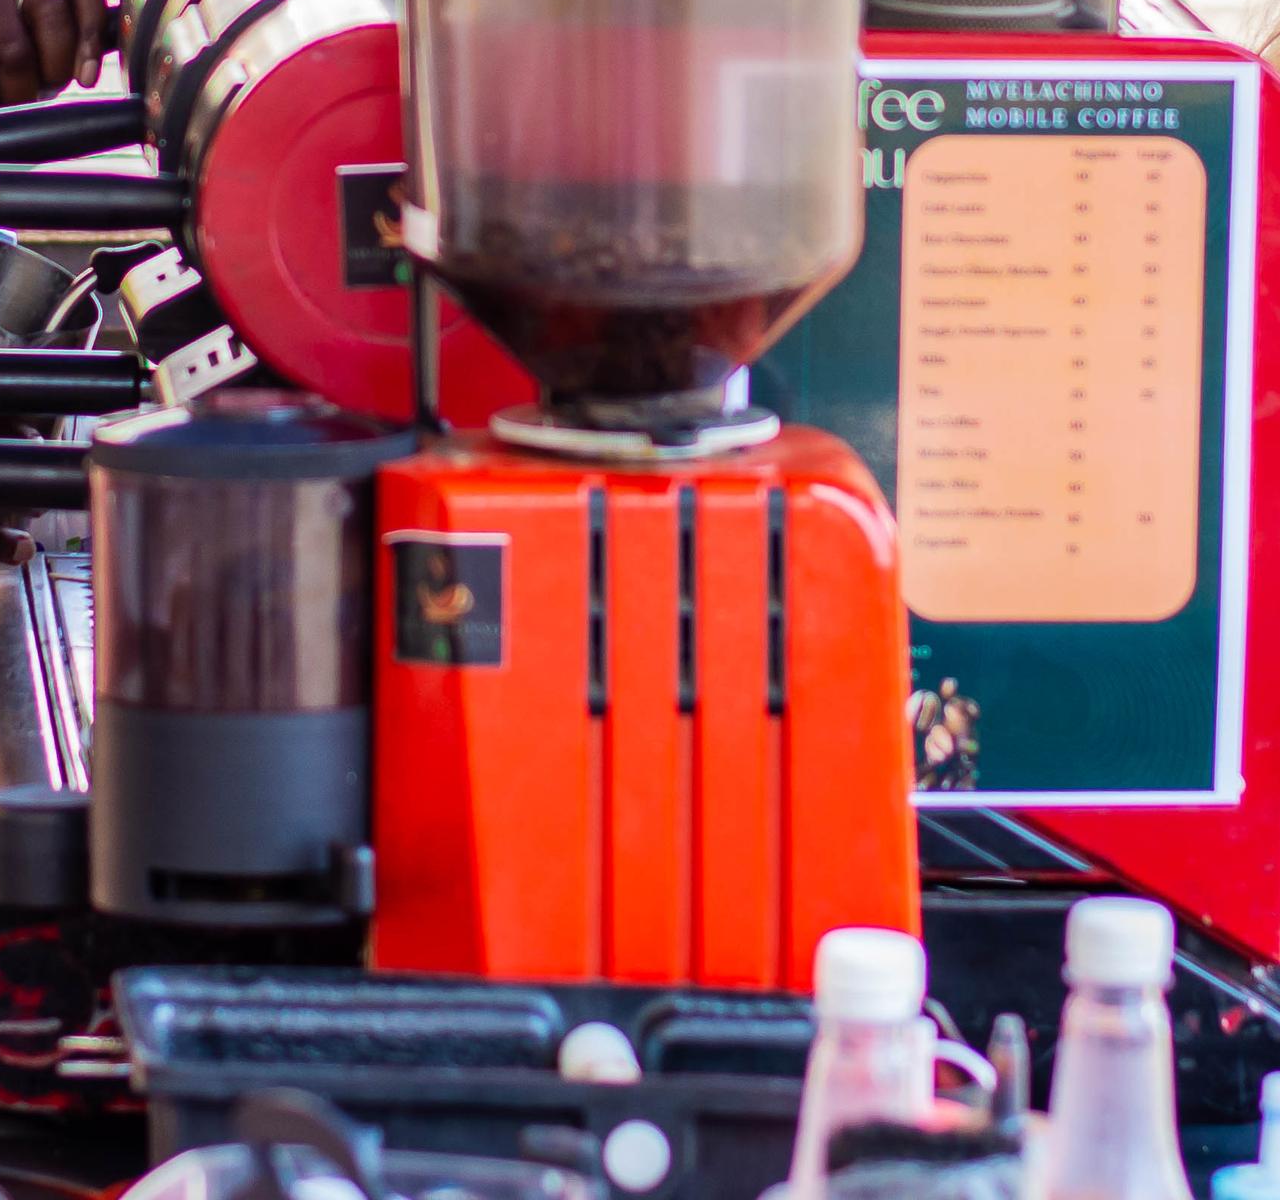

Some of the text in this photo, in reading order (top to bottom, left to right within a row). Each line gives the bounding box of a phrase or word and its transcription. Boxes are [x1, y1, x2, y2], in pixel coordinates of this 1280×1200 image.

[966, 80, 1163, 102] MVELACHINNO
[966, 107, 1180, 129] MOBILE COFFEE
